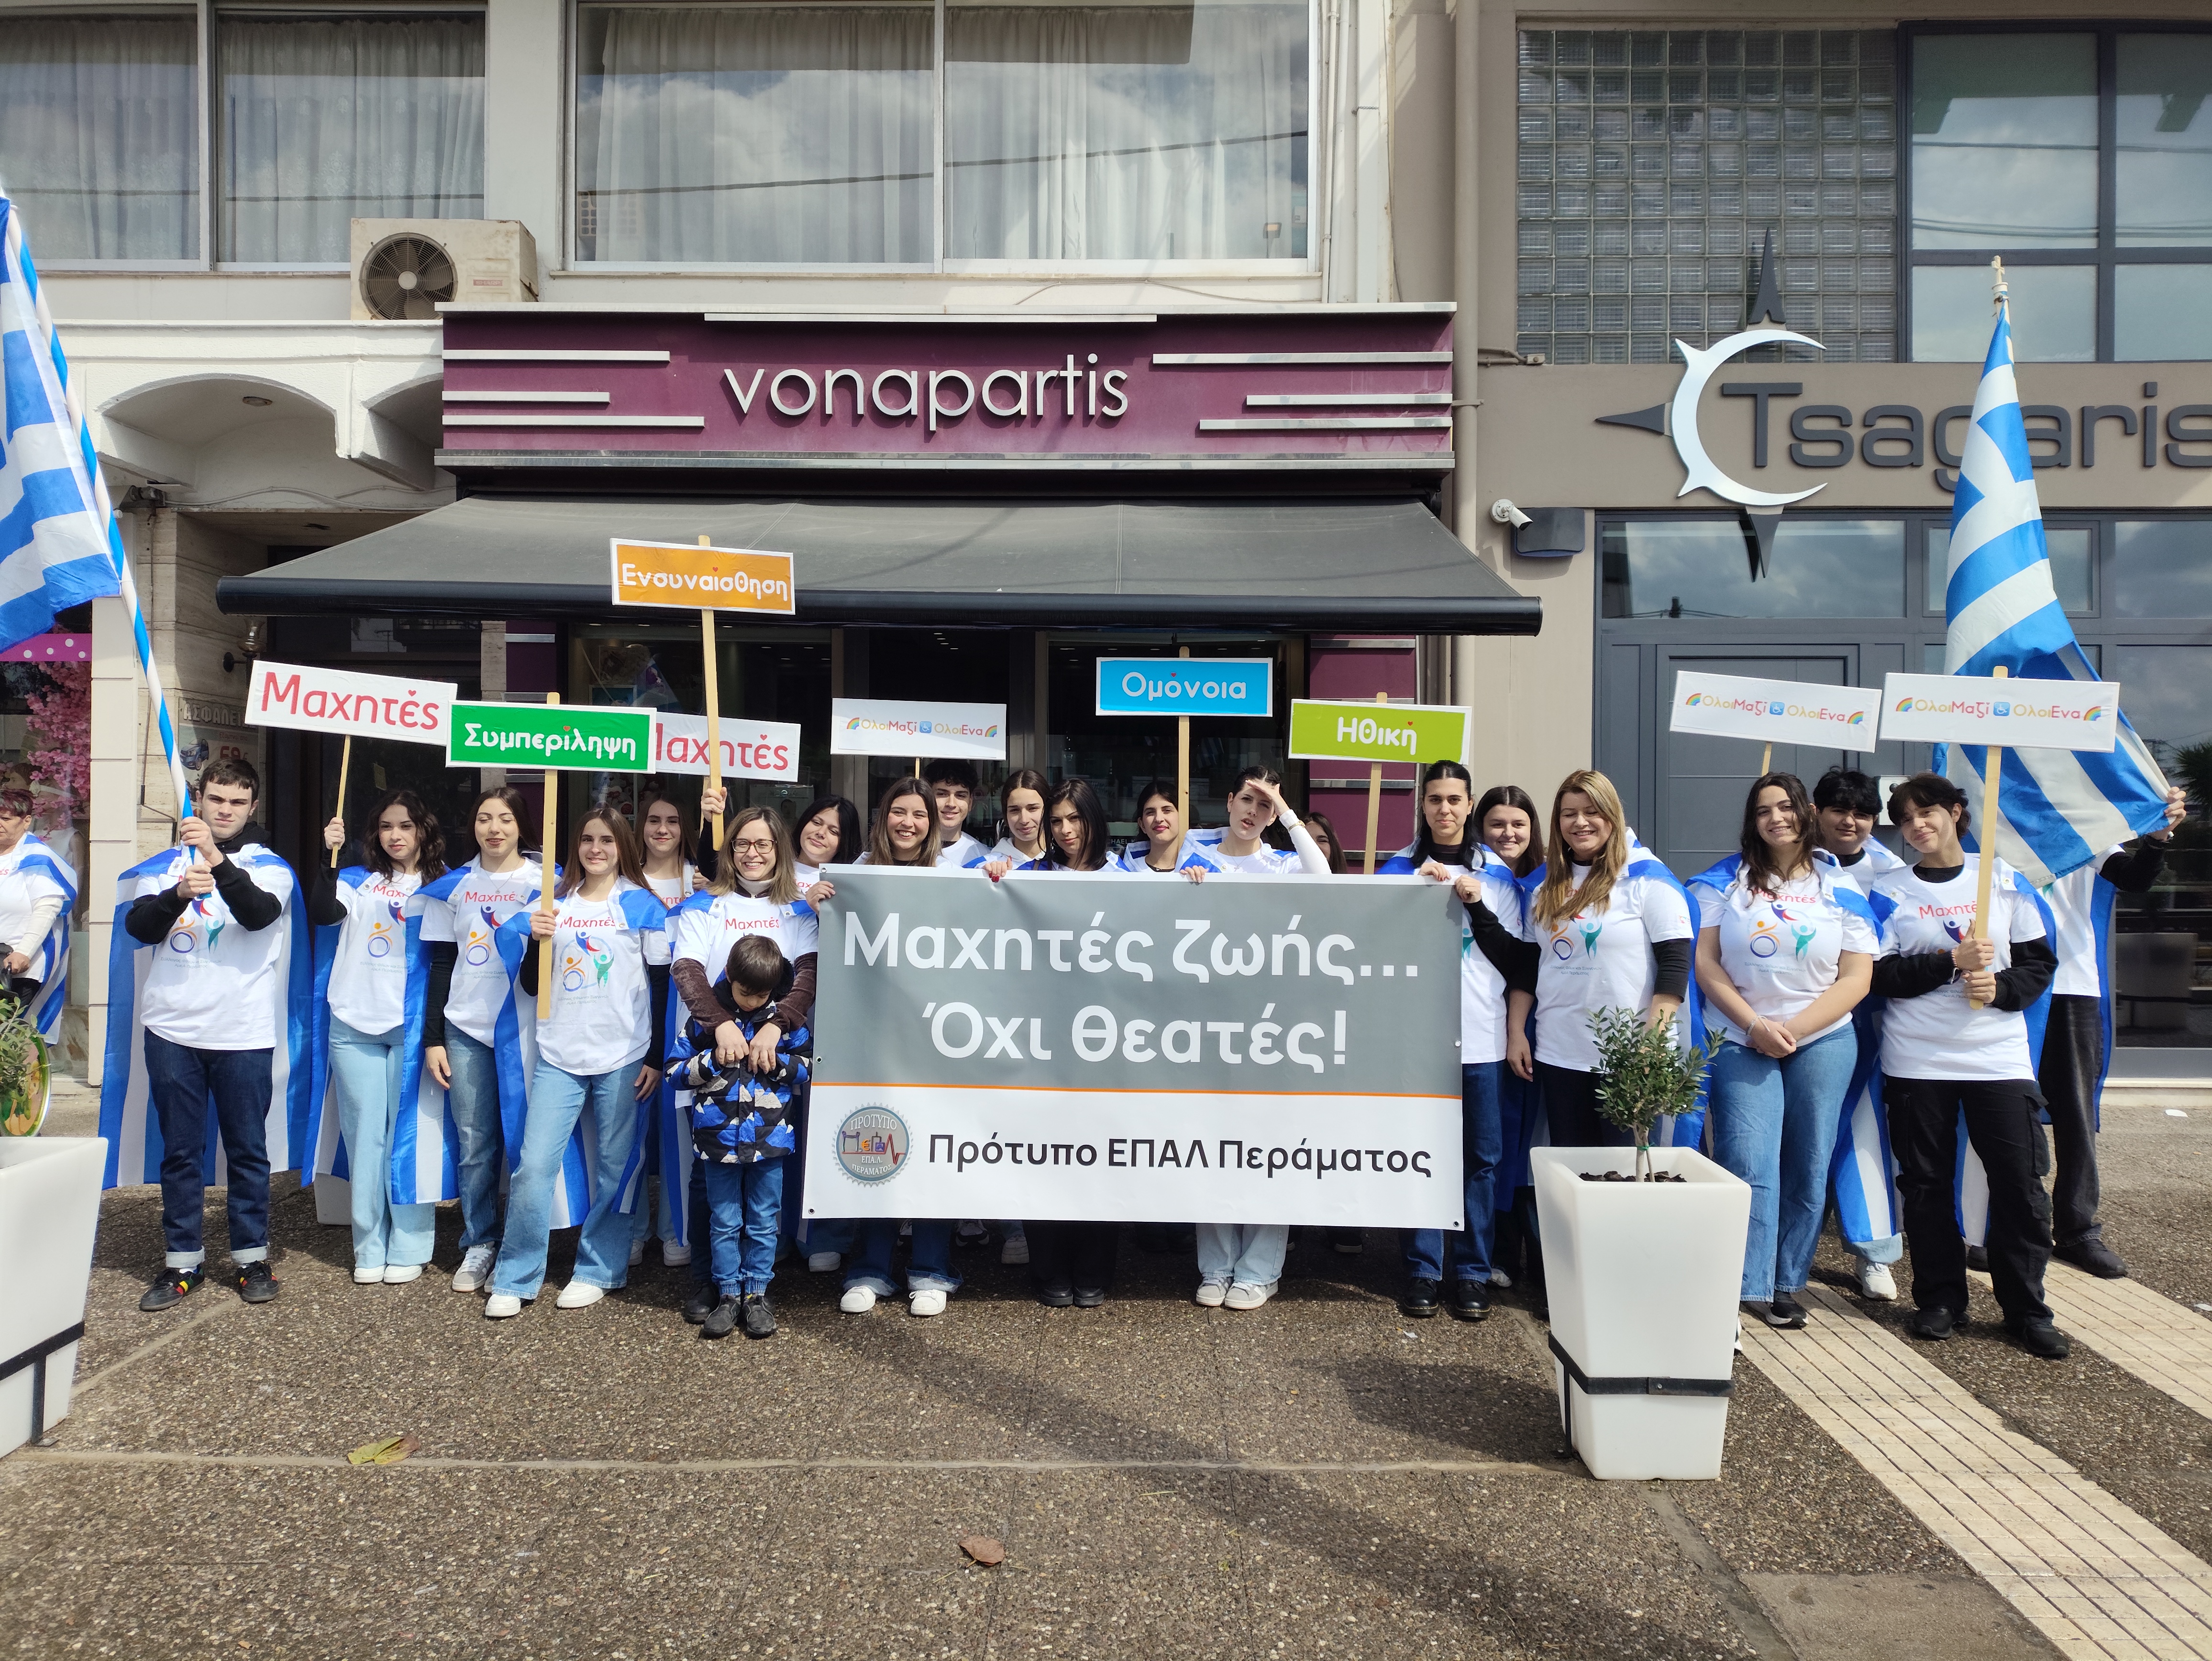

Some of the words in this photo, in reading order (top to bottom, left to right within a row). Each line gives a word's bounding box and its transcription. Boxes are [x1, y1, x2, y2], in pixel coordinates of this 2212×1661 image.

[724, 353, 1128, 431] vonapartis
[1122, 672, 1246, 701] Ομόνοια
[183, 703, 258, 729] ΑΣΦΑΛΕΙ
[262, 672, 439, 731] Μαχητές
[464, 723, 636, 761] Συμπερίληψη
[465, 891, 518, 903] Μαχητέ
[1919, 901, 1977, 919] Μαχητέ
[726, 917, 779, 930] Μαχητές
[844, 910, 1154, 982] Μαχητές
[1172, 914, 1419, 986] ζωής...
[921, 1002, 1052, 1061] Όχι
[850, 1114, 897, 1130] ΠΡΟΤΥΠΟ
[852, 1163, 892, 1175] ΠΕΡΑΜΑΤΟΣ
[929, 1132, 1097, 1173] Πρότυπο
[1108, 1138, 1209, 1168] ΕΠΑΛ
[1219, 1138, 1431, 1179] Περάματος
